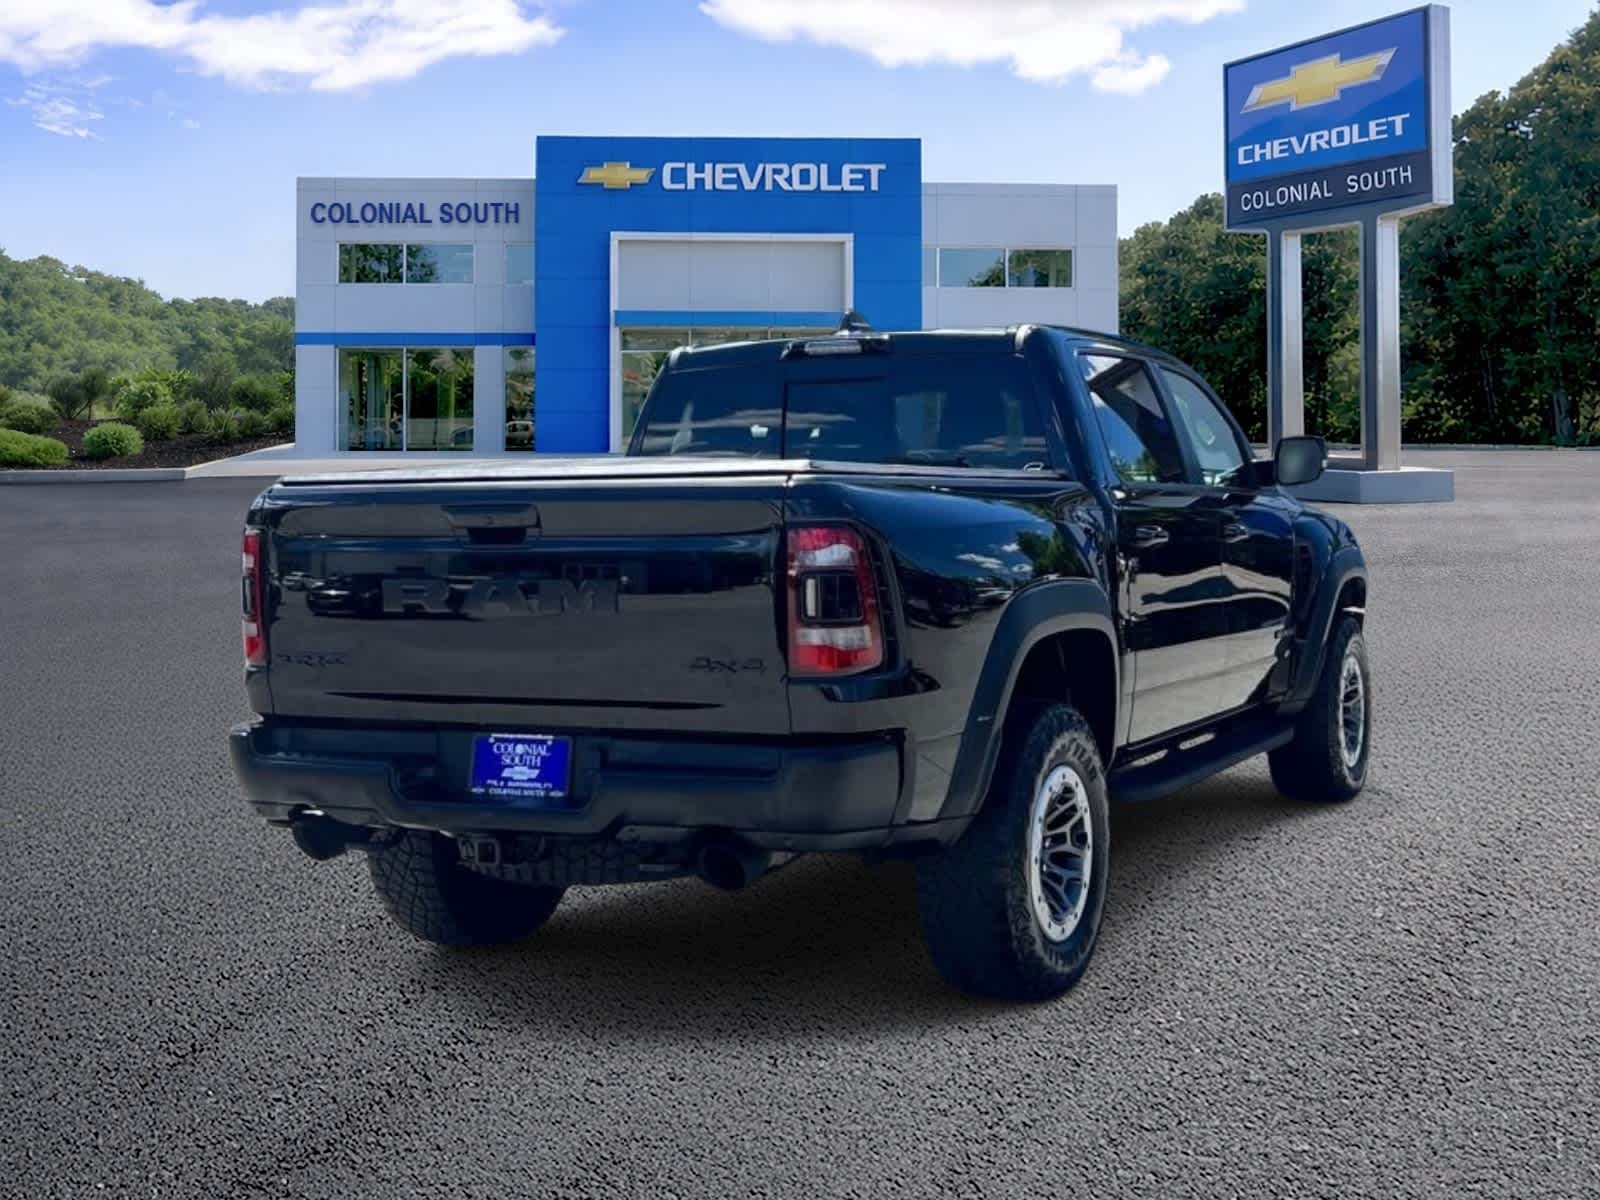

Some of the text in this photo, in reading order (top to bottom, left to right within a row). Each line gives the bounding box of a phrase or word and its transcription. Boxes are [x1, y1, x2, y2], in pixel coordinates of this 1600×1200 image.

[1237, 112, 1410, 165] CHEVROLET
[662, 162, 887, 191] CHEVROLET
[1240, 164, 1413, 212] COLONIAL SOUTH
[310, 202, 520, 224] COLONIAL SOUTH
[382, 578, 619, 616] RAM
[501, 754, 541, 768] SOUTH
